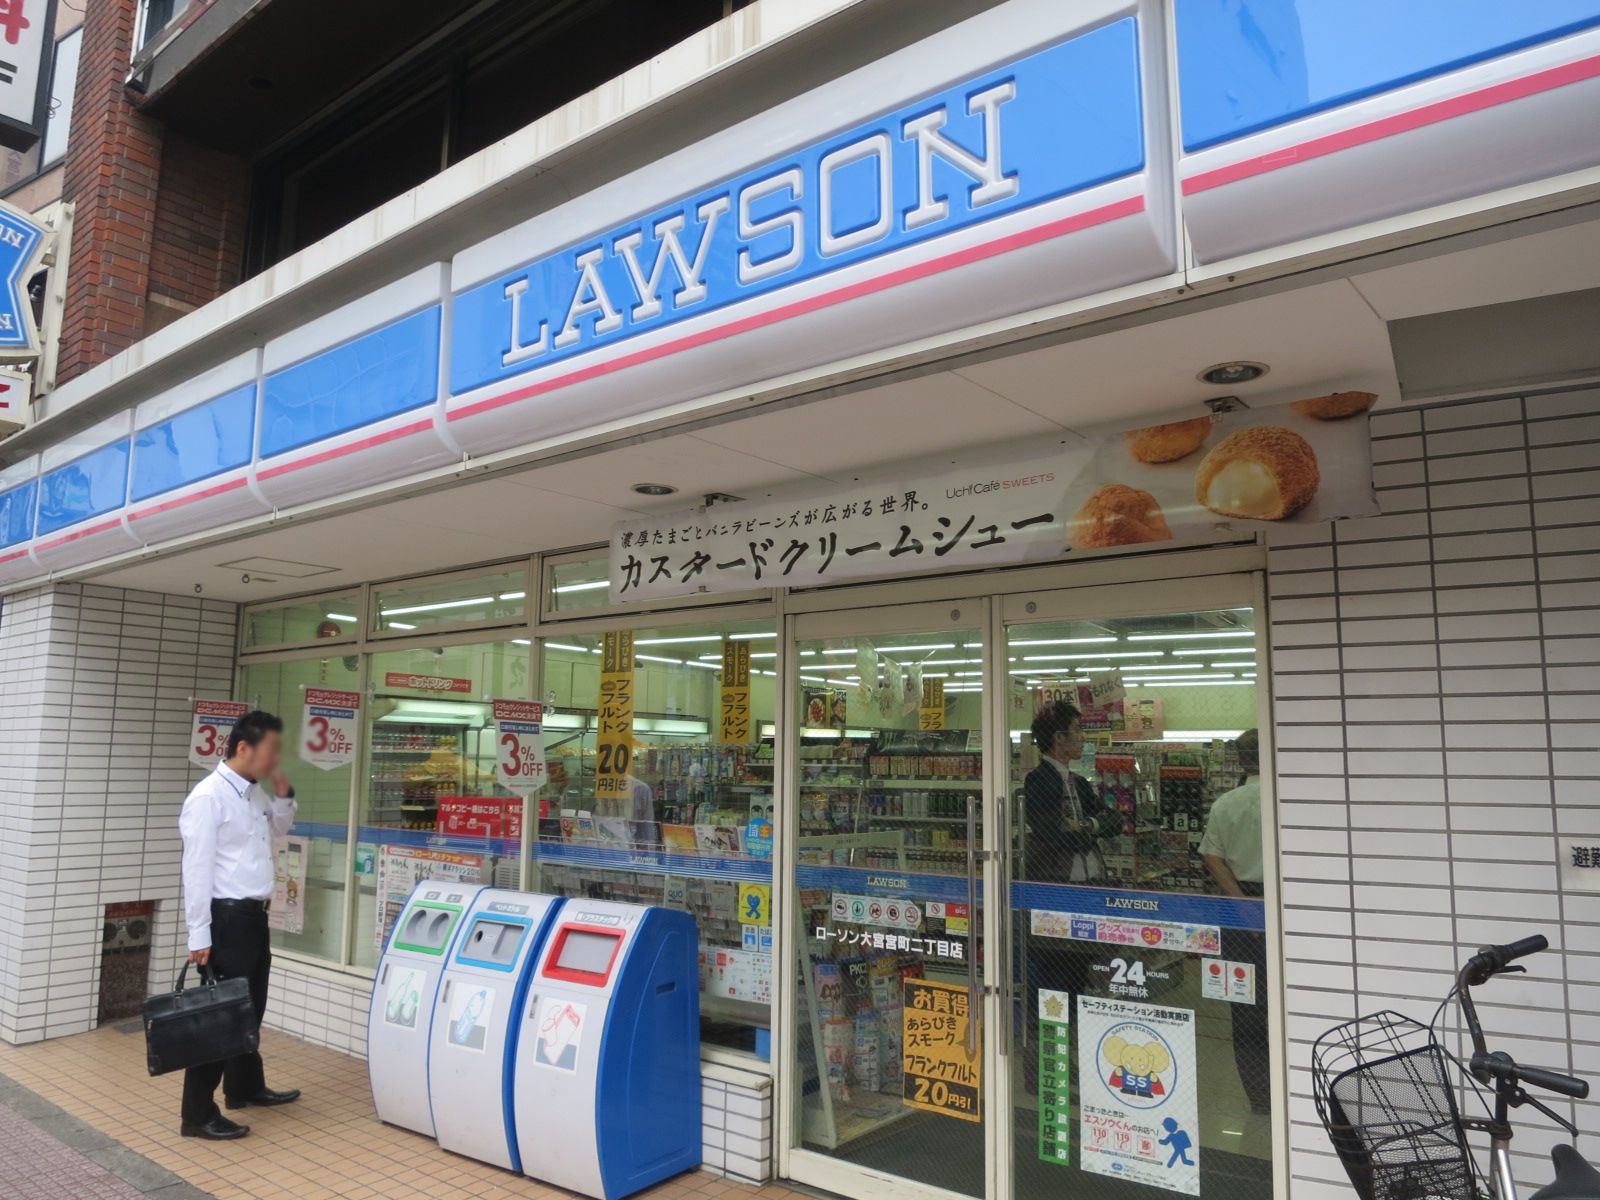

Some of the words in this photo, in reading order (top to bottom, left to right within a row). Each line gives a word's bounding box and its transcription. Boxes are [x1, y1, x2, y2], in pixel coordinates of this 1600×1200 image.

[502, 80, 1019, 368] LAWSON
[1001, 472, 1055, 490] SWEETS
[620, 490, 929, 549] 濃厚たまごとバニラビーンズが広がる世界。
[619, 512, 1055, 594] カスタードクリームシュー
[195, 725, 218, 757] 3
[307, 717, 329, 753] 3
[329, 742, 353, 755] OFF
[501, 733, 521, 776] 3
[599, 743, 629, 775] 20
[522, 763, 543, 777] OFF
[597, 778, 628, 792] 円引き
[867, 876, 909, 888] LAWSON
[1105, 897, 1159, 911] LAWSON
[816, 927, 963, 959] ローソン大宮宮町二丁目店
[1092, 964, 1110, 973] OPEN
[1109, 957, 1147, 985] 24
[1146, 971, 1170, 980] HOURS
[913, 988, 970, 1018] お買得
[1109, 983, 1149, 999] 年中無休
[1082, 1000, 1190, 1022] セーフティステーション活動実施店
[907, 1017, 957, 1031] あらびき
[908, 1032, 956, 1048] スモーク
[905, 1055, 977, 1081] フランクフルト
[1126, 1074, 1147, 1088] SS
